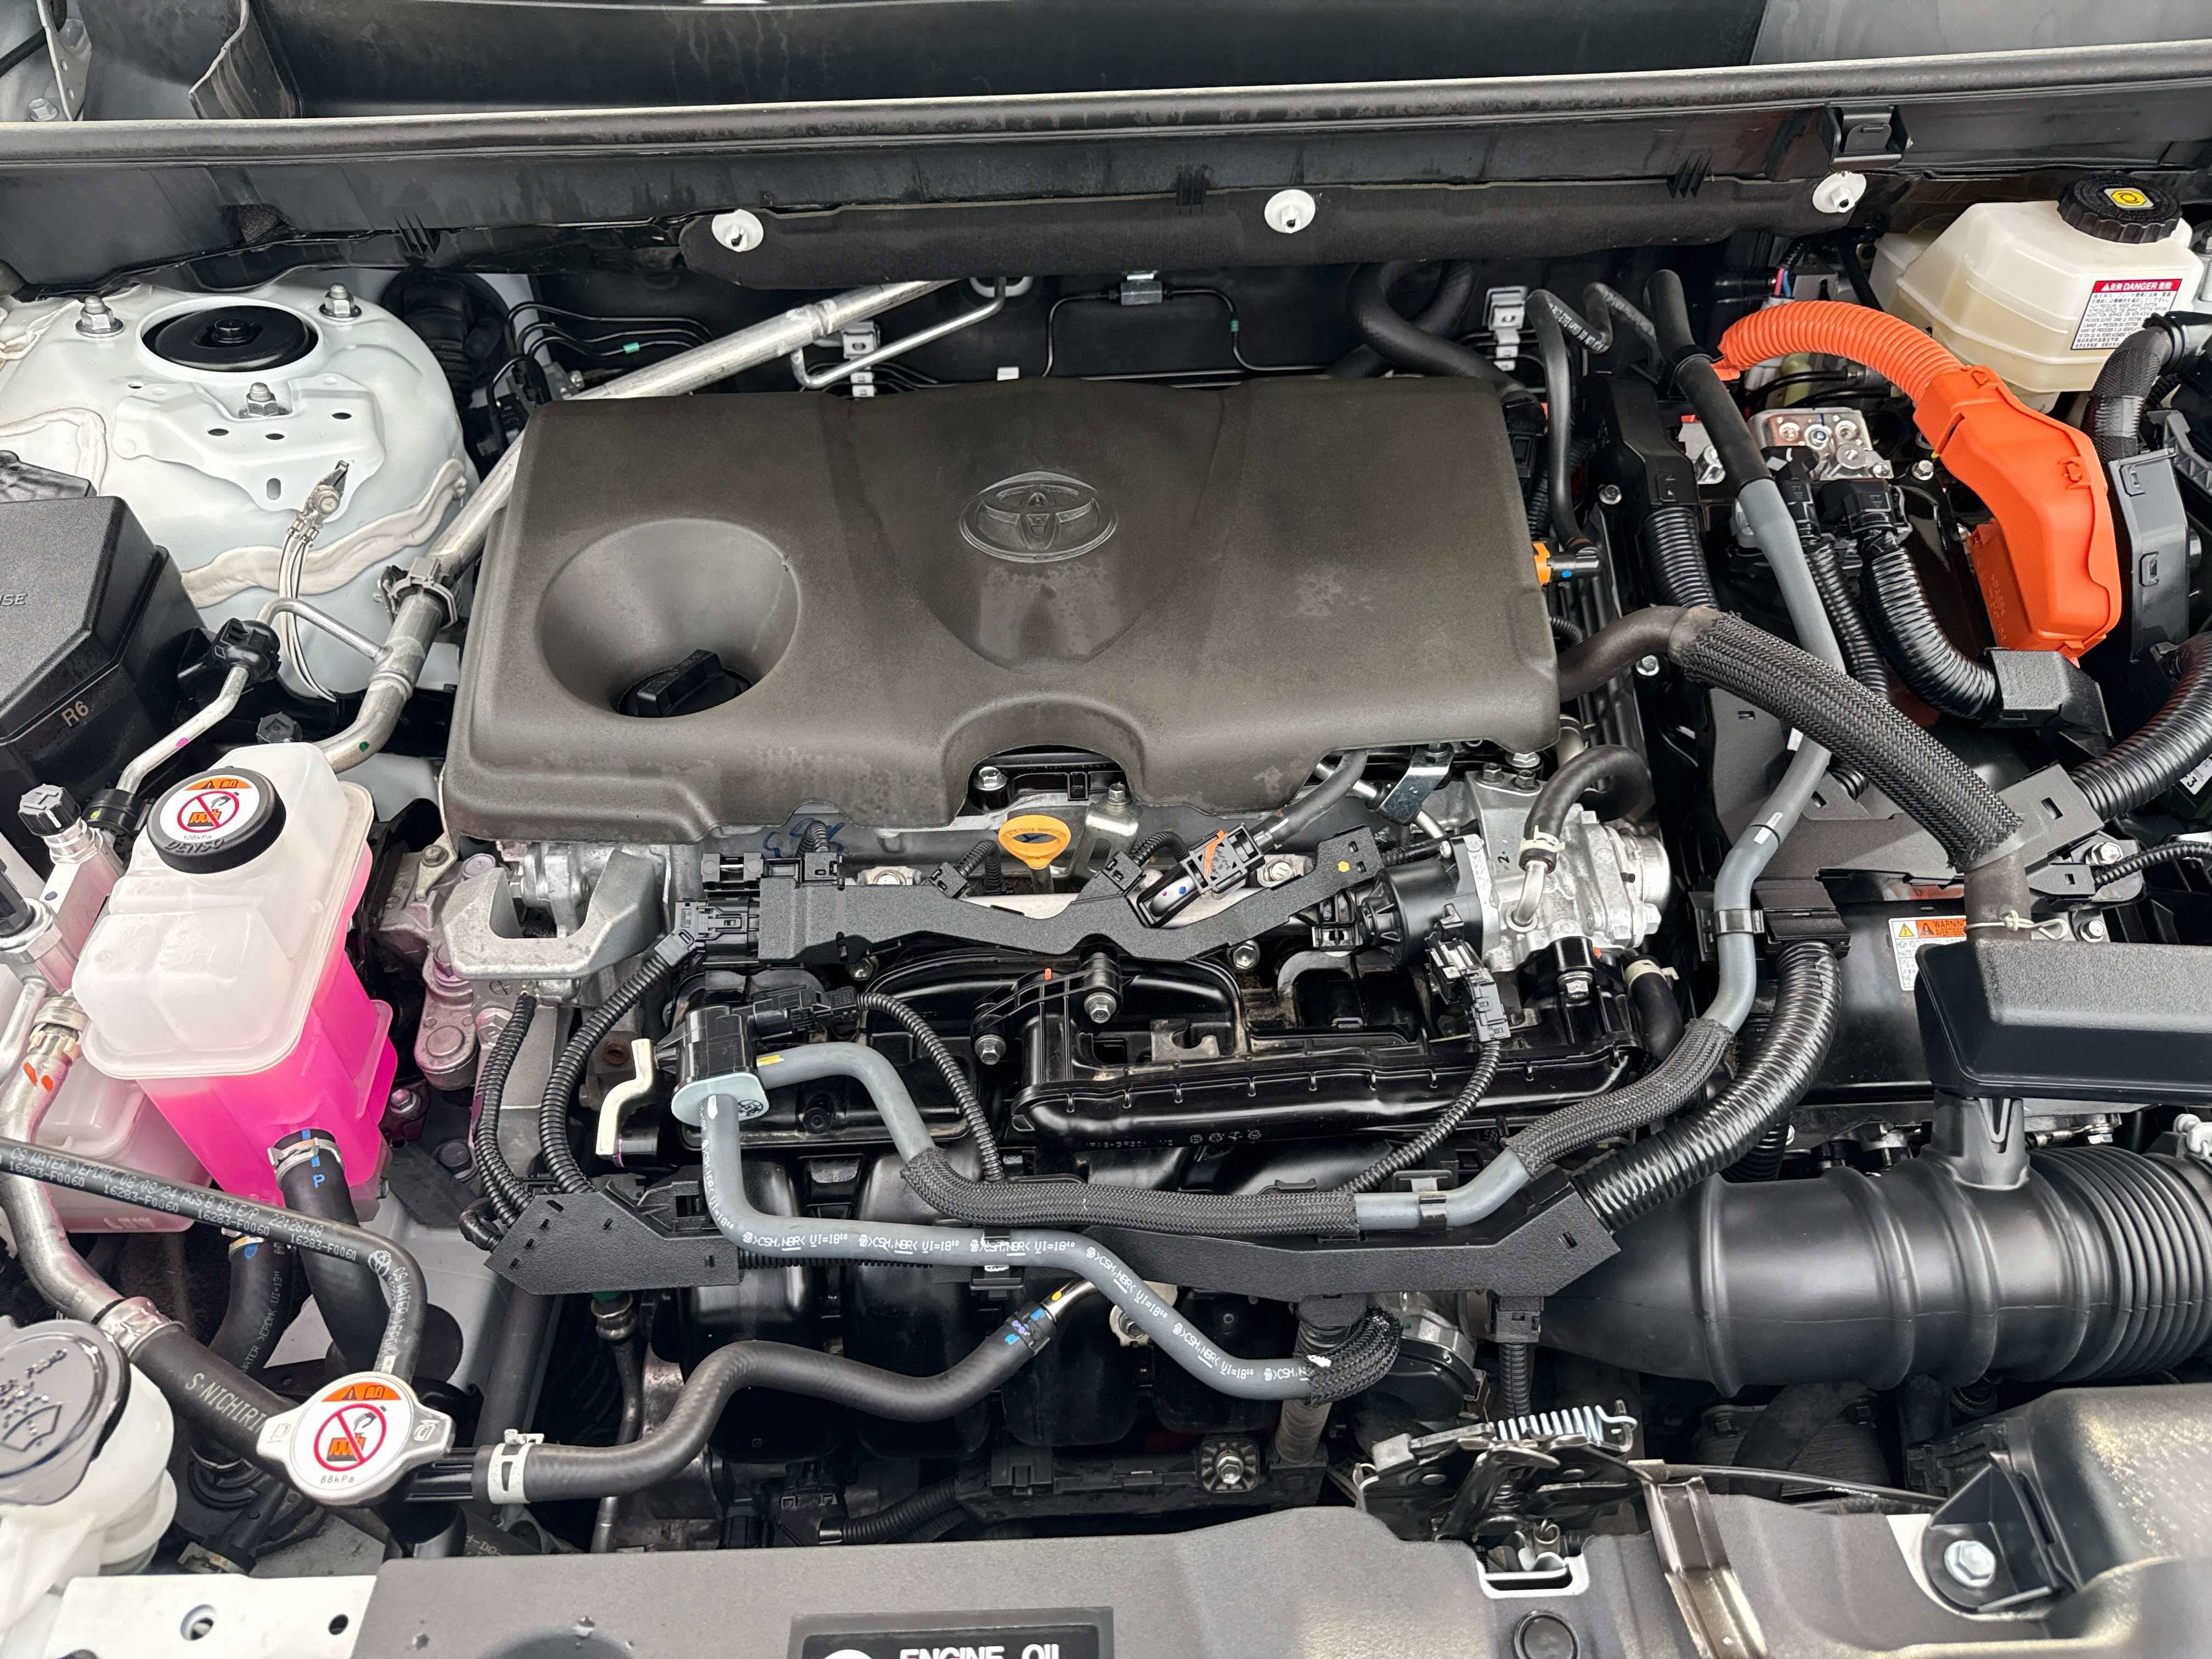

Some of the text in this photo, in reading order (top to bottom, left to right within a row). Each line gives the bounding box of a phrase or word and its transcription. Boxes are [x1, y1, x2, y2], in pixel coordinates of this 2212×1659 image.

[61, 700, 89, 727] R6
[165, 838, 225, 854] DENSO
[10, 1148, 27, 1161] CS
[30, 1153, 70, 1172] WATER
[236, 1205, 259, 1219] E/P
[312, 1173, 325, 1188] P
[8, 1160, 85, 1187] 16283-F0060
[103, 1183, 180, 1213] 16283-F0060
[197, 1208, 270, 1237] 16283-F0060
[289, 1233, 357, 1261] 16283-F0060
[320, 1475, 355, 1485] 88kPa
